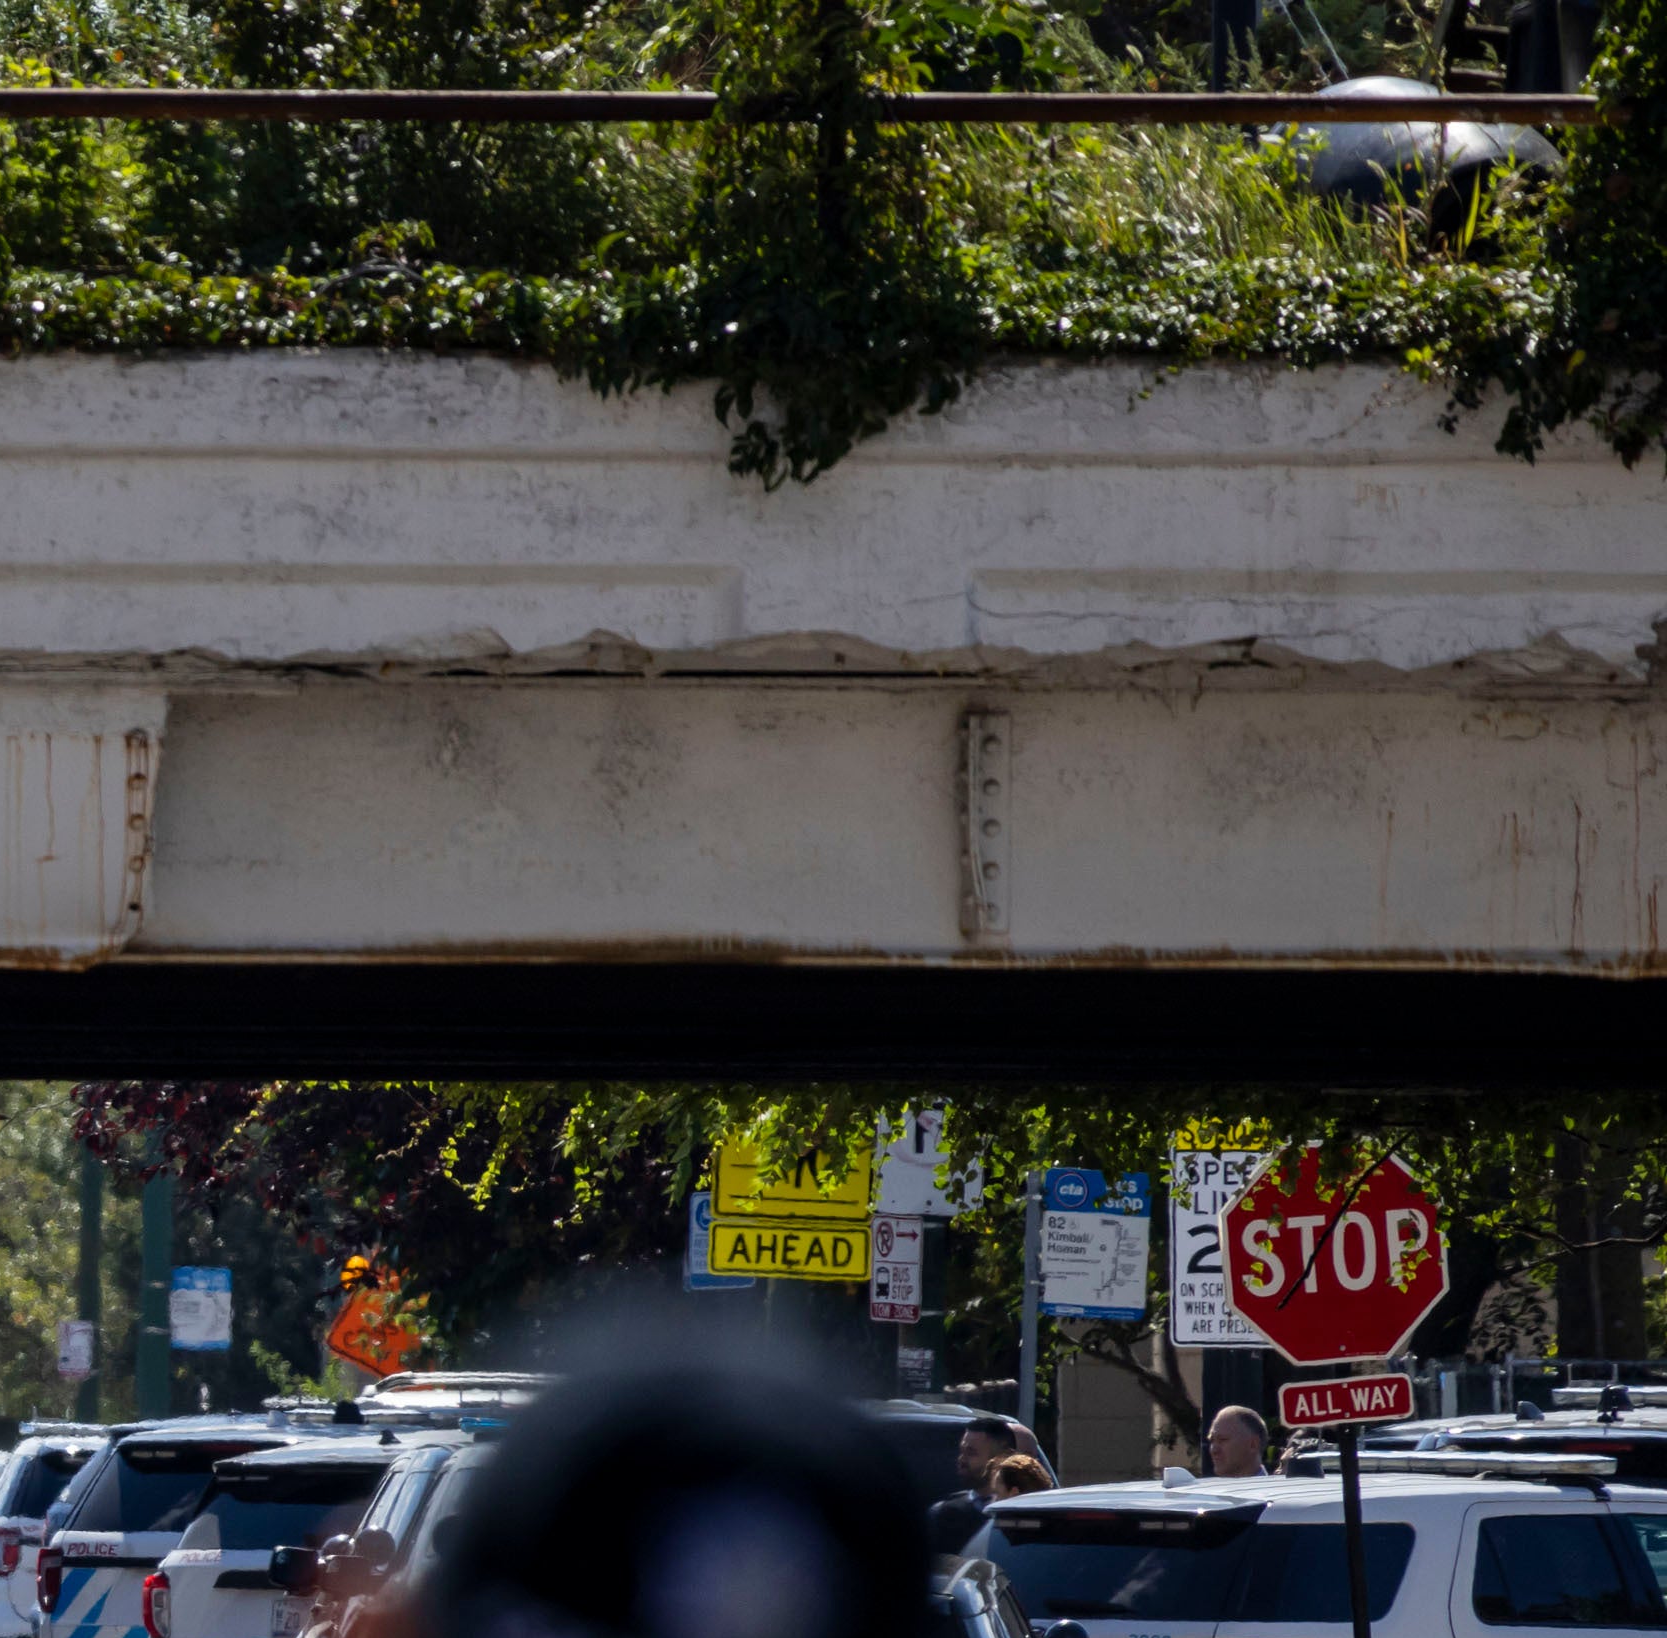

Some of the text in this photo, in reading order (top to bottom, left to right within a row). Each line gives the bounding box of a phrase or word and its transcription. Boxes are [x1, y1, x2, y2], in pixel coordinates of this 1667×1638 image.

[1059, 1183, 1084, 1196] cta
[1048, 1216, 1065, 1229] 82
[727, 1231, 854, 1269] AHEAD
[1241, 1208, 1429, 1298] STOP
[892, 1267, 910, 1282] BUS
[891, 1285, 914, 1300] STOP
[1180, 1283, 1196, 1297] ON
[1184, 1302, 1216, 1316] WHEN
[1192, 1320, 1212, 1334] ARE
[1295, 1383, 1399, 1418] ALL WAY
[67, 1541, 119, 1556] POLICE
